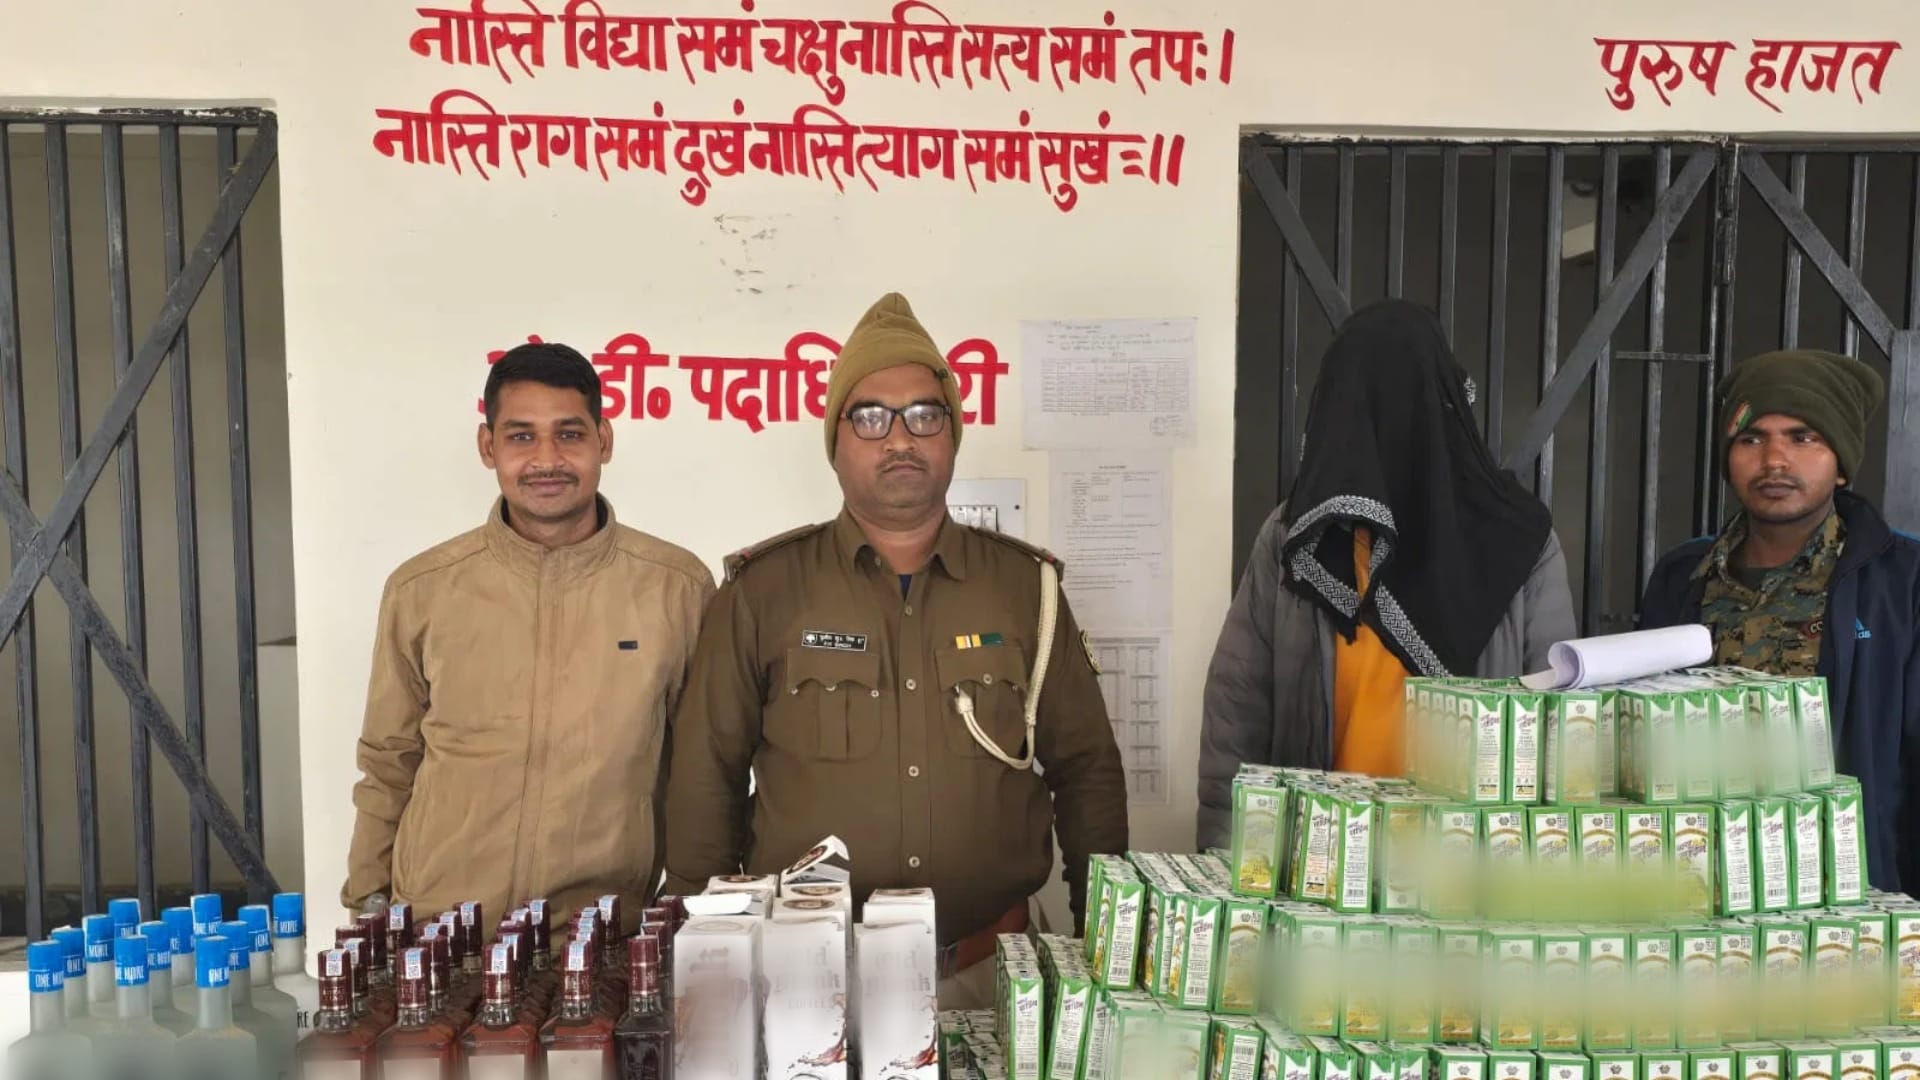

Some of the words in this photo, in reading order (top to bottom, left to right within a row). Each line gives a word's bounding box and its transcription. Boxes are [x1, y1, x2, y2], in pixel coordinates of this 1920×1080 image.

[557, 0, 674, 71] विद्या
[675, 0, 760, 85] समं
[1050, 10, 1126, 92] समं
[1593, 37, 1737, 111] पुरुष
[1745, 38, 1903, 113] हाजत
[507, 114, 592, 178] राग
[593, 101, 672, 182] समं
[855, 125, 959, 193] त्याग
[962, 109, 1035, 194] समं
